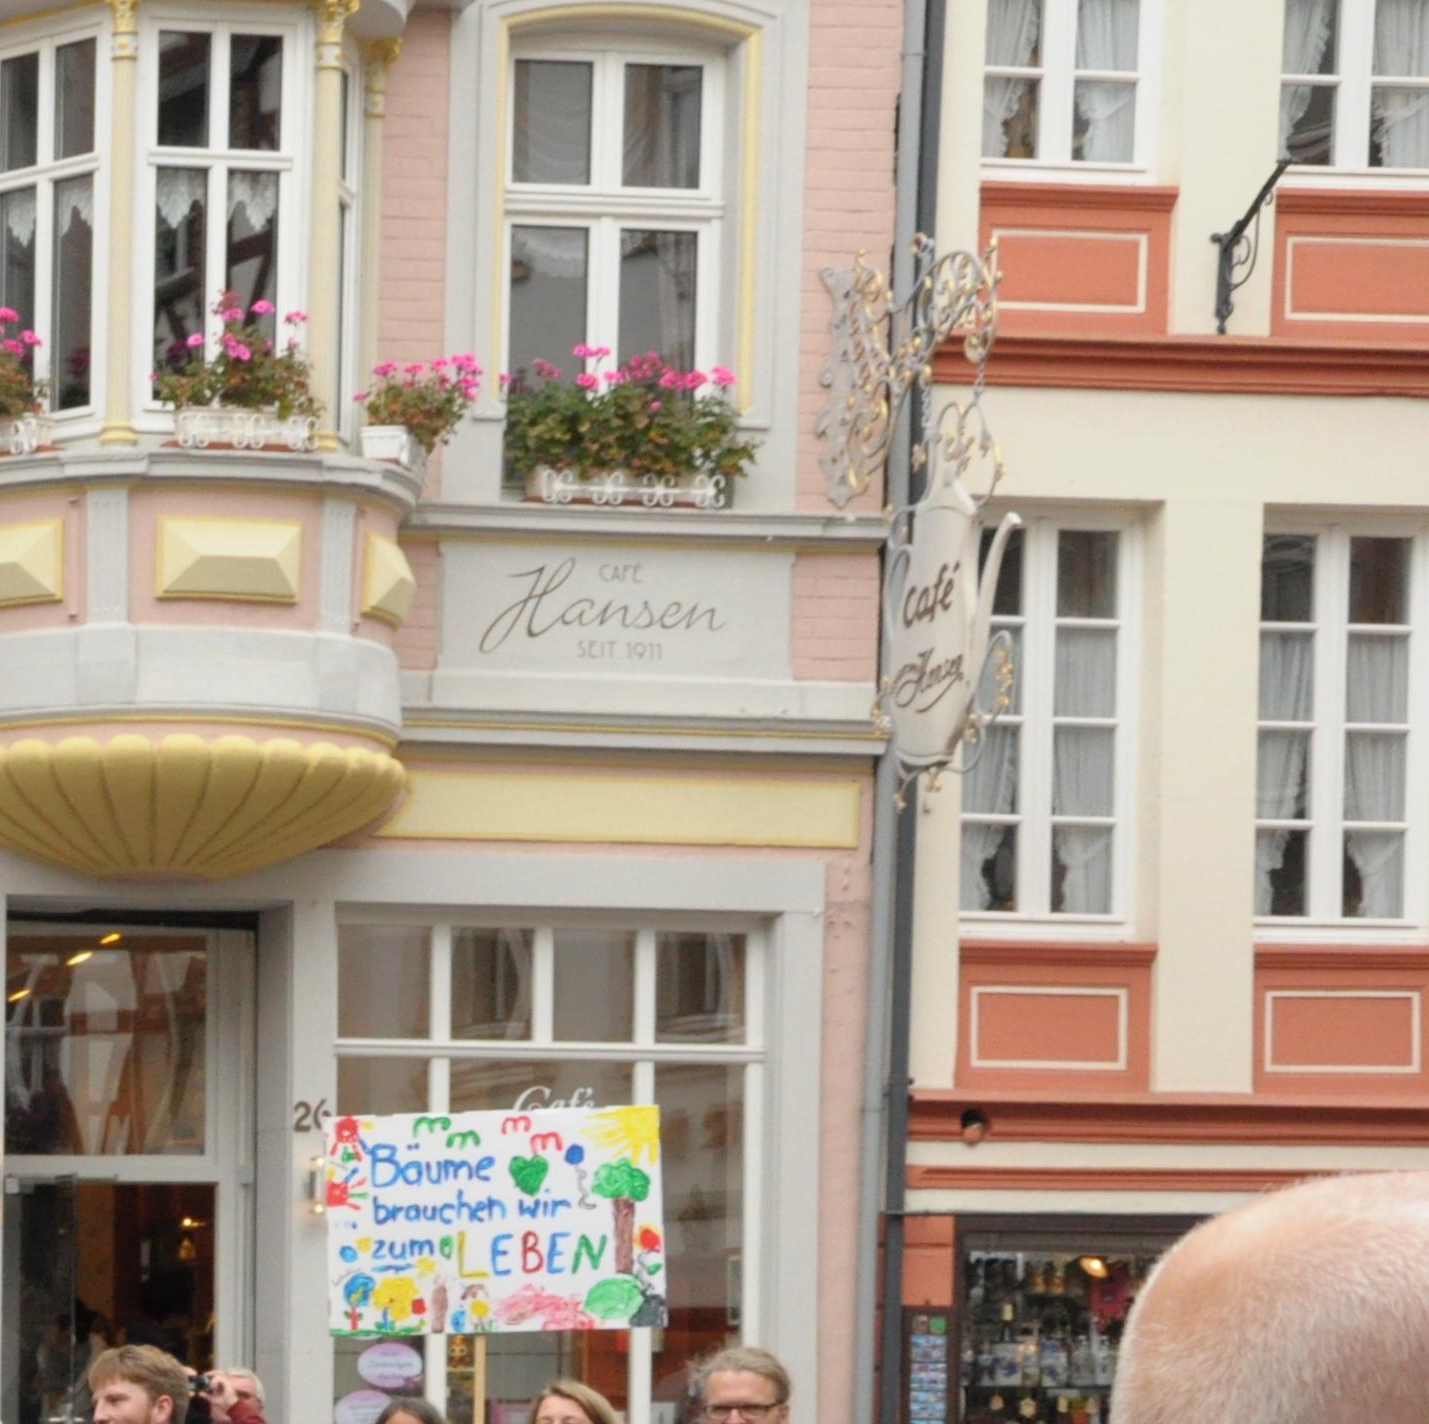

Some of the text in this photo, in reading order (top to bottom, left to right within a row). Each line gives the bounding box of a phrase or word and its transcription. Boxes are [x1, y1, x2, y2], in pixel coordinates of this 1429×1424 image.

[598, 562, 644, 583] CAFÉ
[903, 562, 960, 629] café
[478, 557, 726, 654] Hansen
[576, 640, 663, 661] SEIT 1911
[370, 1141, 497, 1189] Bäume
[372, 1187, 572, 1225] brauchen wir
[371, 1229, 608, 1279] zum LEBEN
